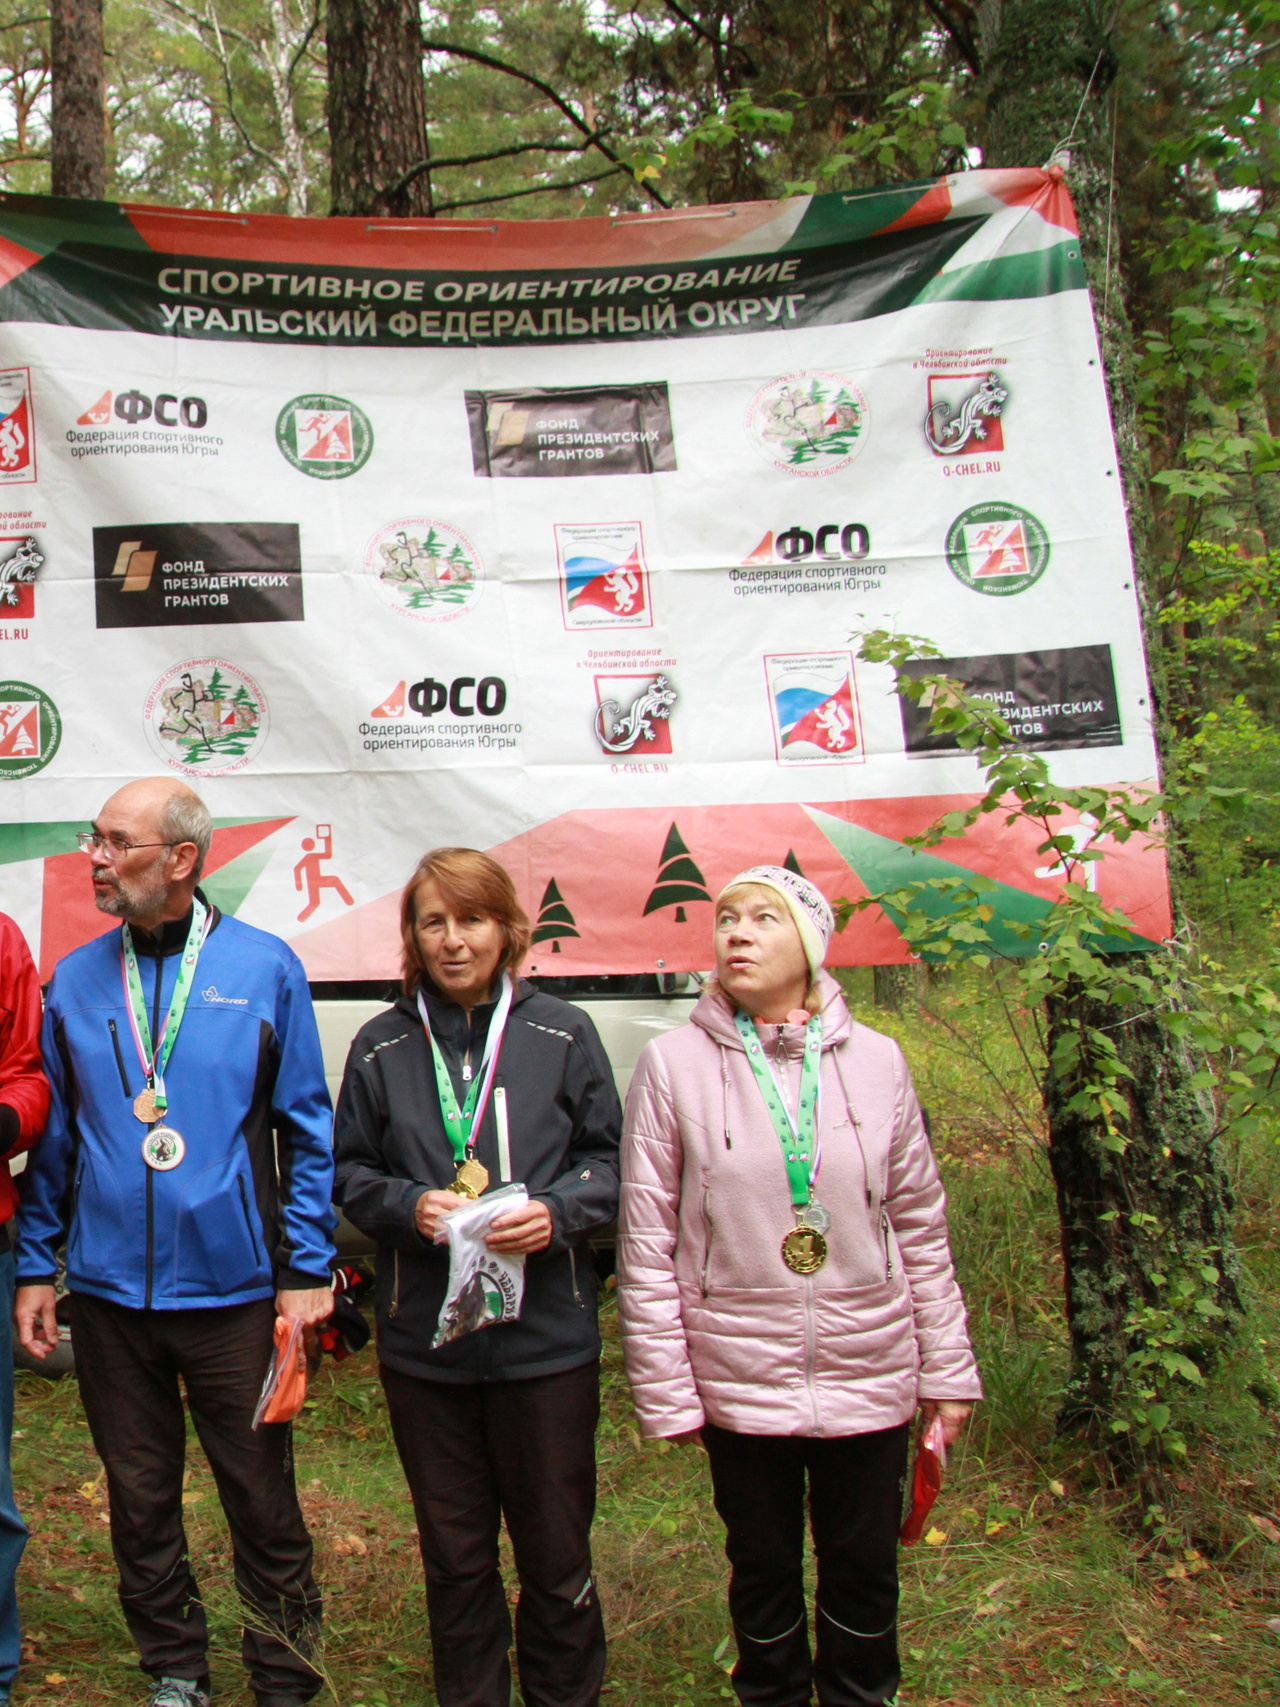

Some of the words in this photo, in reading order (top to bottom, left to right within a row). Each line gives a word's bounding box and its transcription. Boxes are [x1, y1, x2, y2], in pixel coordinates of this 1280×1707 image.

[157, 267, 424, 301] СПОРТИВНОЕ
[434, 259, 802, 302] ОРИЕНТИРОВАНИЕ
[158, 303, 378, 338] УРАЛЬСКИЙ
[388, 297, 676, 342] ФЕДЕРАЛЬНЫЙ
[687, 294, 806, 327] ОКРУГ
[114, 388, 208, 429] ФСО
[536, 418, 579, 432] ФОНД
[66, 430, 139, 443] Федерация
[142, 431, 224, 445] спортивного
[537, 430, 660, 446] ПРЕЗИДЕНТСКИХ
[71, 443, 179, 459] ориентирования
[181, 443, 219, 457] Югры
[539, 447, 604, 461] ГРАНТОВ
[942, 461, 1001, 477] O-CHEL.RU
[9, 520, 47, 530] области
[775, 523, 870, 562] ФСО
[162, 560, 205, 575] ФОНД
[728, 567, 802, 582] Федерация
[805, 564, 886, 580] спортивного
[163, 576, 289, 591] ПРЕЗИДЕНТСКИХ
[733, 580, 841, 597] ориентирования
[844, 578, 881, 593] Югры
[164, 593, 229, 607] ГРАНТОВ
[587, 648, 662, 659] Ориентирование
[639, 658, 677, 667] области
[144, 676, 166, 719] ФЕДЕРАЦИЯ
[166, 659, 216, 678] СПОРТИВНОГО
[218, 660, 266, 713] ОРИЕНТИРОВАНИЯ
[408, 677, 507, 717] ФСО
[973, 700, 1104, 720] ЗИДЕНТСКИХ
[358, 722, 434, 737] Федерация
[438, 721, 522, 738] спортивного
[363, 736, 474, 753] ориентирования
[478, 736, 517, 750] Югры
[610, 763, 669, 774] O-CHEL.RU
[210, 997, 249, 1005] NORD
